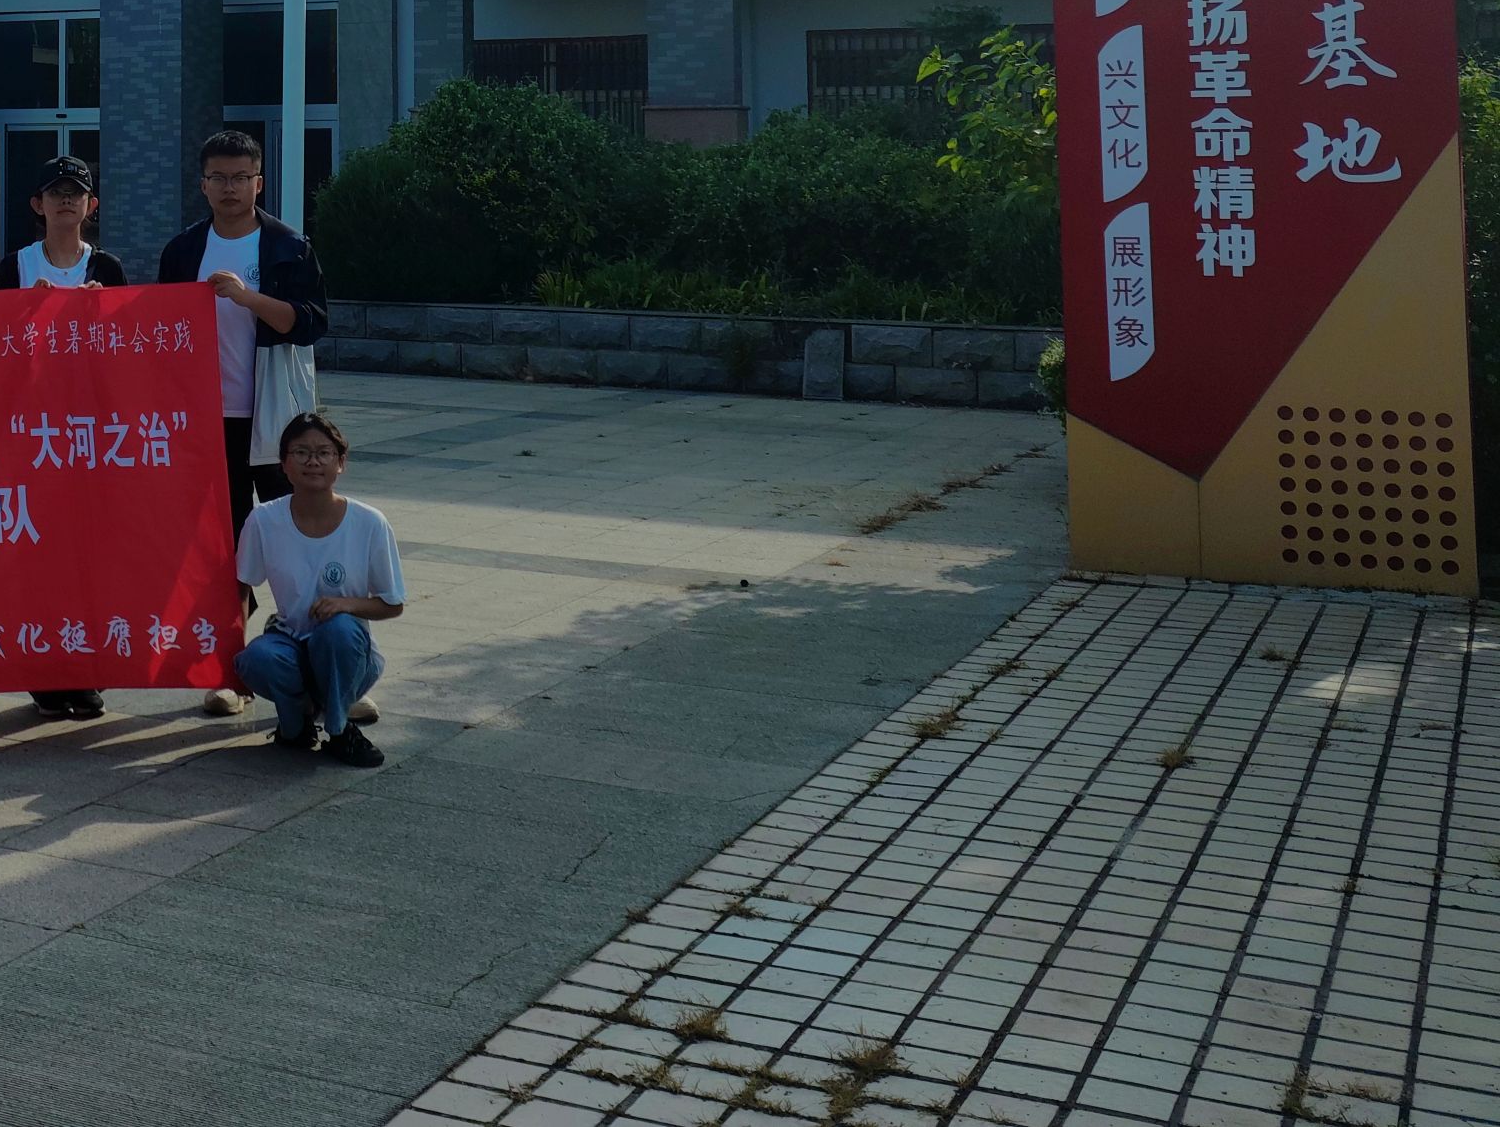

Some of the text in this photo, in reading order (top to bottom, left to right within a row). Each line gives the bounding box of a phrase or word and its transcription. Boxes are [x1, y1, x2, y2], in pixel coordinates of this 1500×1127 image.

[1104, 59, 1143, 170] 兴文化
[1111, 236, 1149, 348] 展形象
